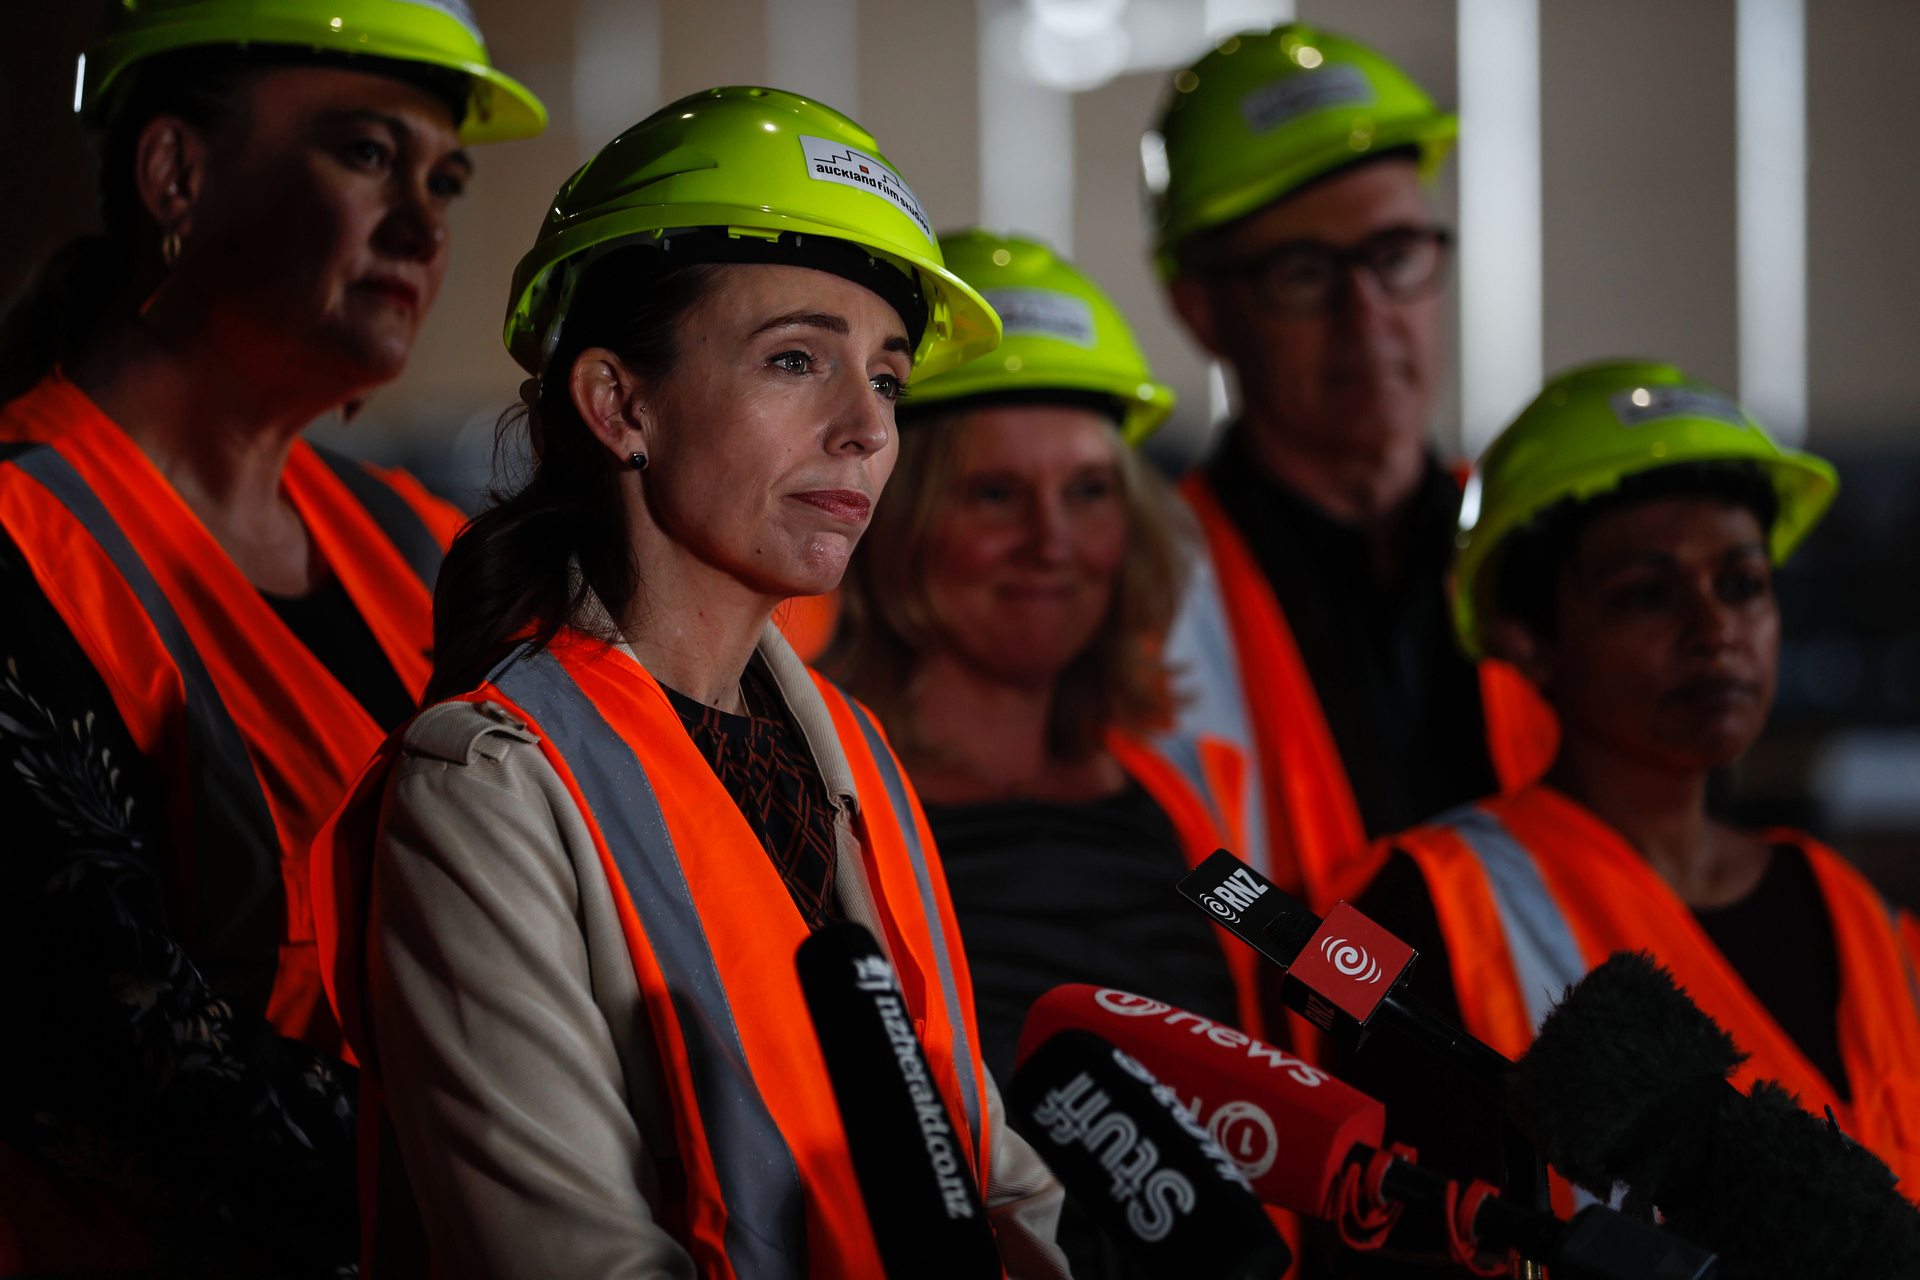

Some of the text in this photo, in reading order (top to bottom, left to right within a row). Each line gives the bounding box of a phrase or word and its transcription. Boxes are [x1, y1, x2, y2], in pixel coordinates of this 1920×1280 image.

[816, 164, 876, 187] auckland
[1213, 867, 1269, 913] RNZ
[1304, 993, 1336, 1031] RNZ
[1164, 1011, 1330, 1087] news
[1033, 1071, 1196, 1242] Stuff
